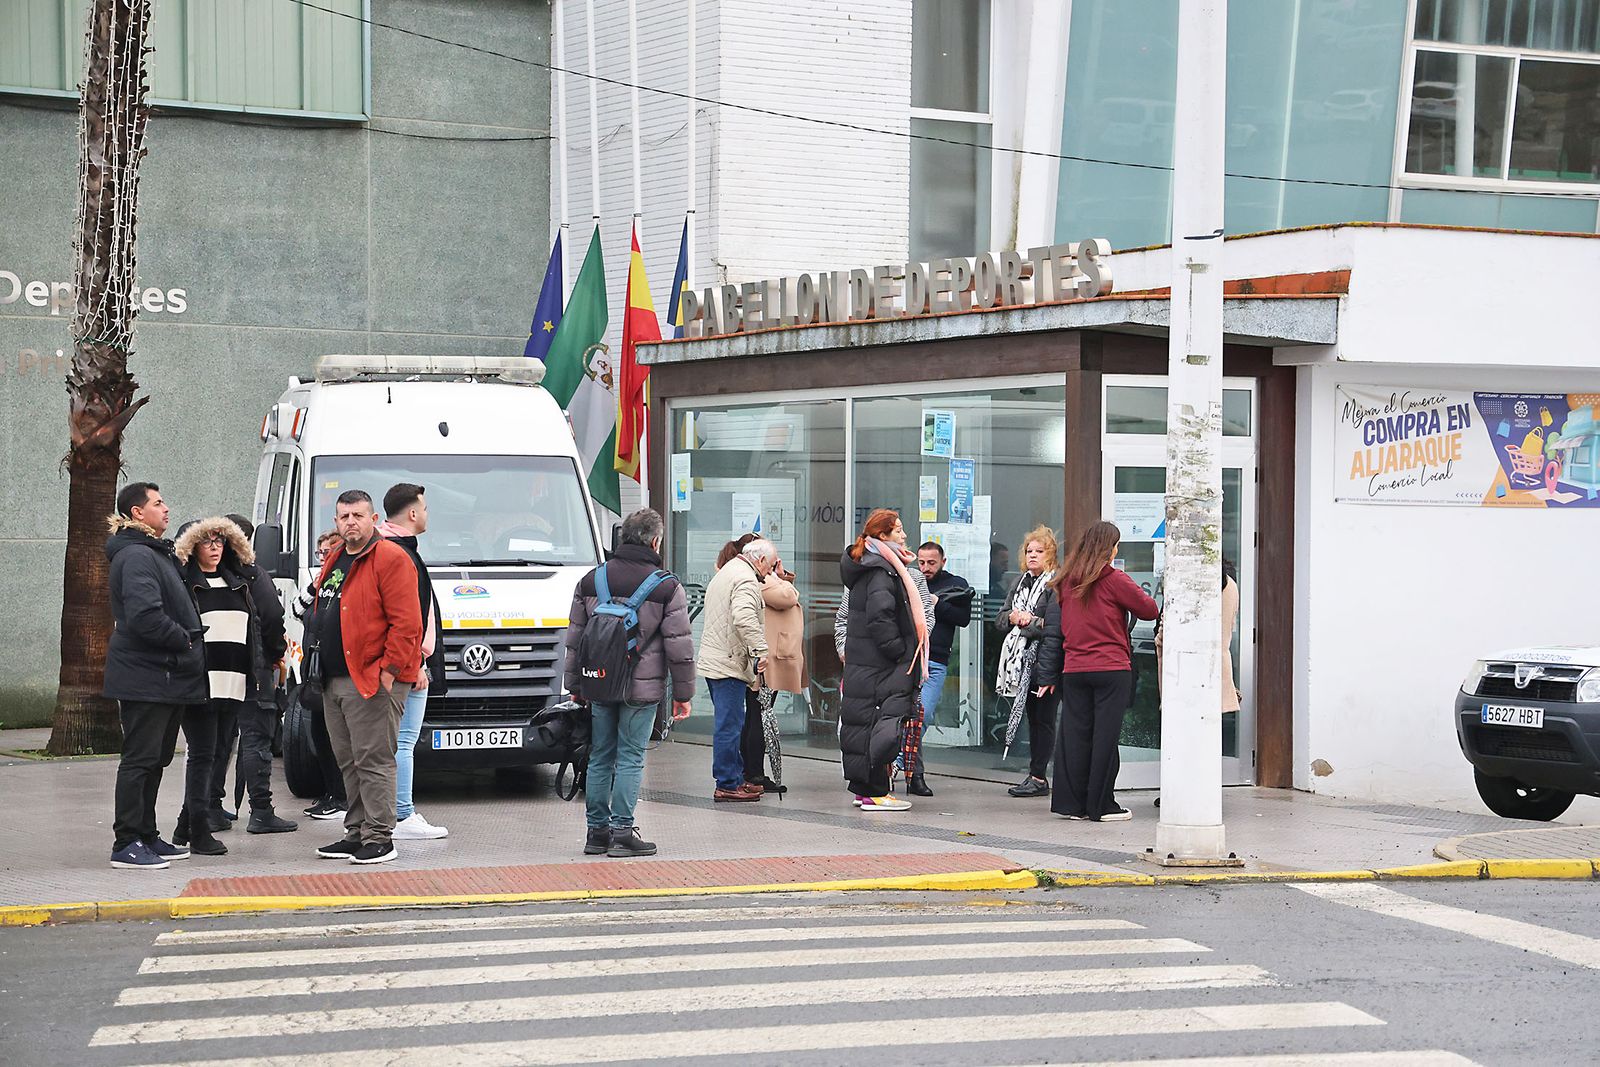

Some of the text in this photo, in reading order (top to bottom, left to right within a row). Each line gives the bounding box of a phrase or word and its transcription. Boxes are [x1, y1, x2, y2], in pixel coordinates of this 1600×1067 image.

[681, 238, 1113, 338] PABELLON DE DEPORTES
[1363, 403, 1471, 446] COMPRA EN
[1350, 432, 1462, 480] ALJARAQUE
[1420, 458, 1454, 487] Local
[1488, 706, 1541, 725] 5627 HBT
[446, 730, 518, 746] 1018 GZR
